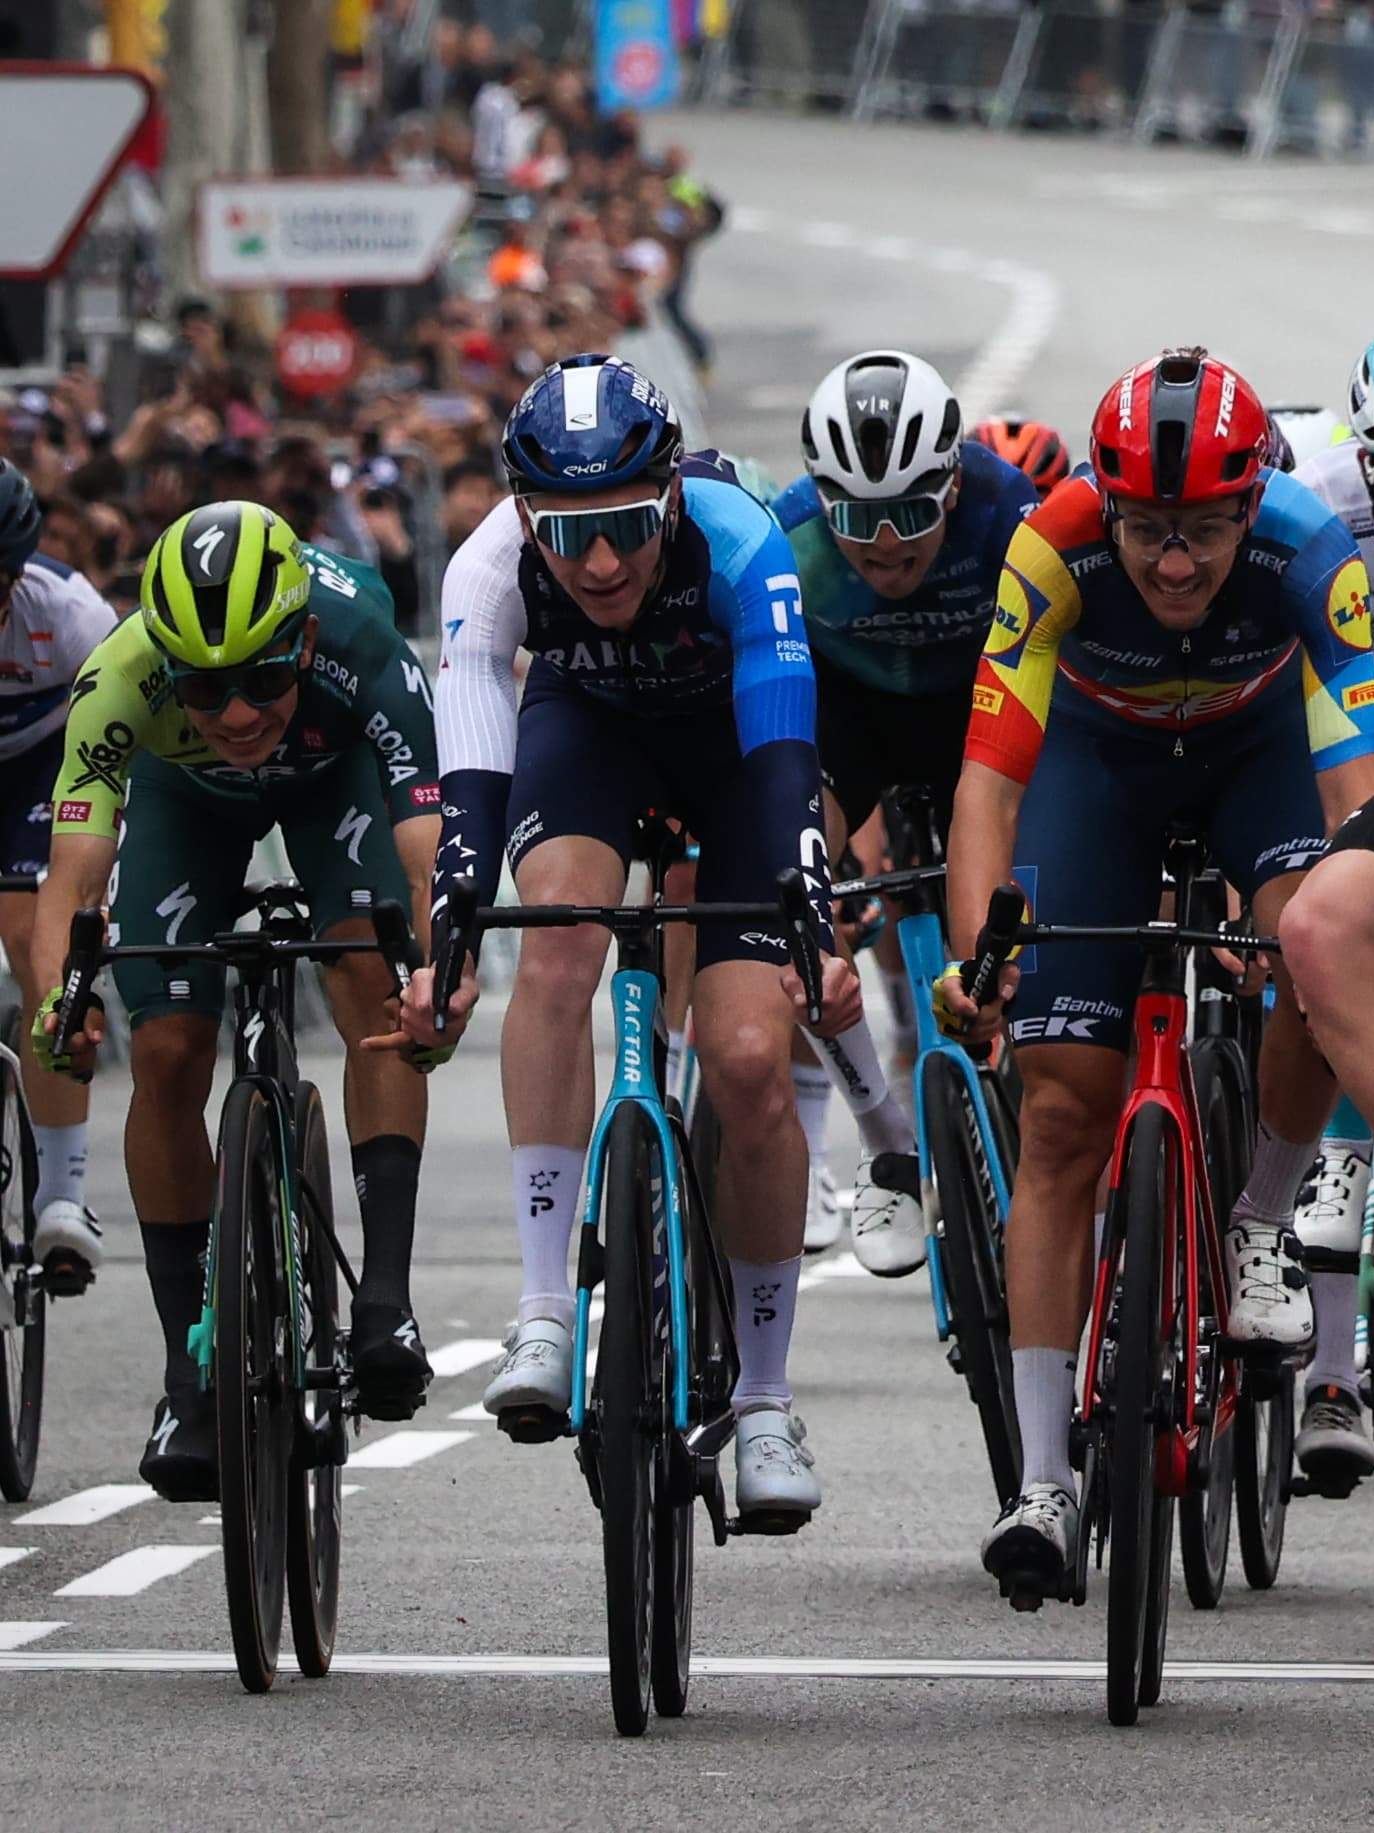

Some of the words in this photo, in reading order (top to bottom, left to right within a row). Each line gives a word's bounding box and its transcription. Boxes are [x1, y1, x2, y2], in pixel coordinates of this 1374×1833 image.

[1068, 551, 1114, 578] TRE
[1249, 550, 1290, 576] REK
[777, 651, 808, 663] TECH
[313, 653, 360, 696] BORA
[363, 711, 420, 787] BORA
[61, 812, 85, 820] TAL
[1051, 996, 1124, 1019] Santini
[623, 982, 641, 1082] FACTOR
[1011, 1016, 1101, 1041] EK
